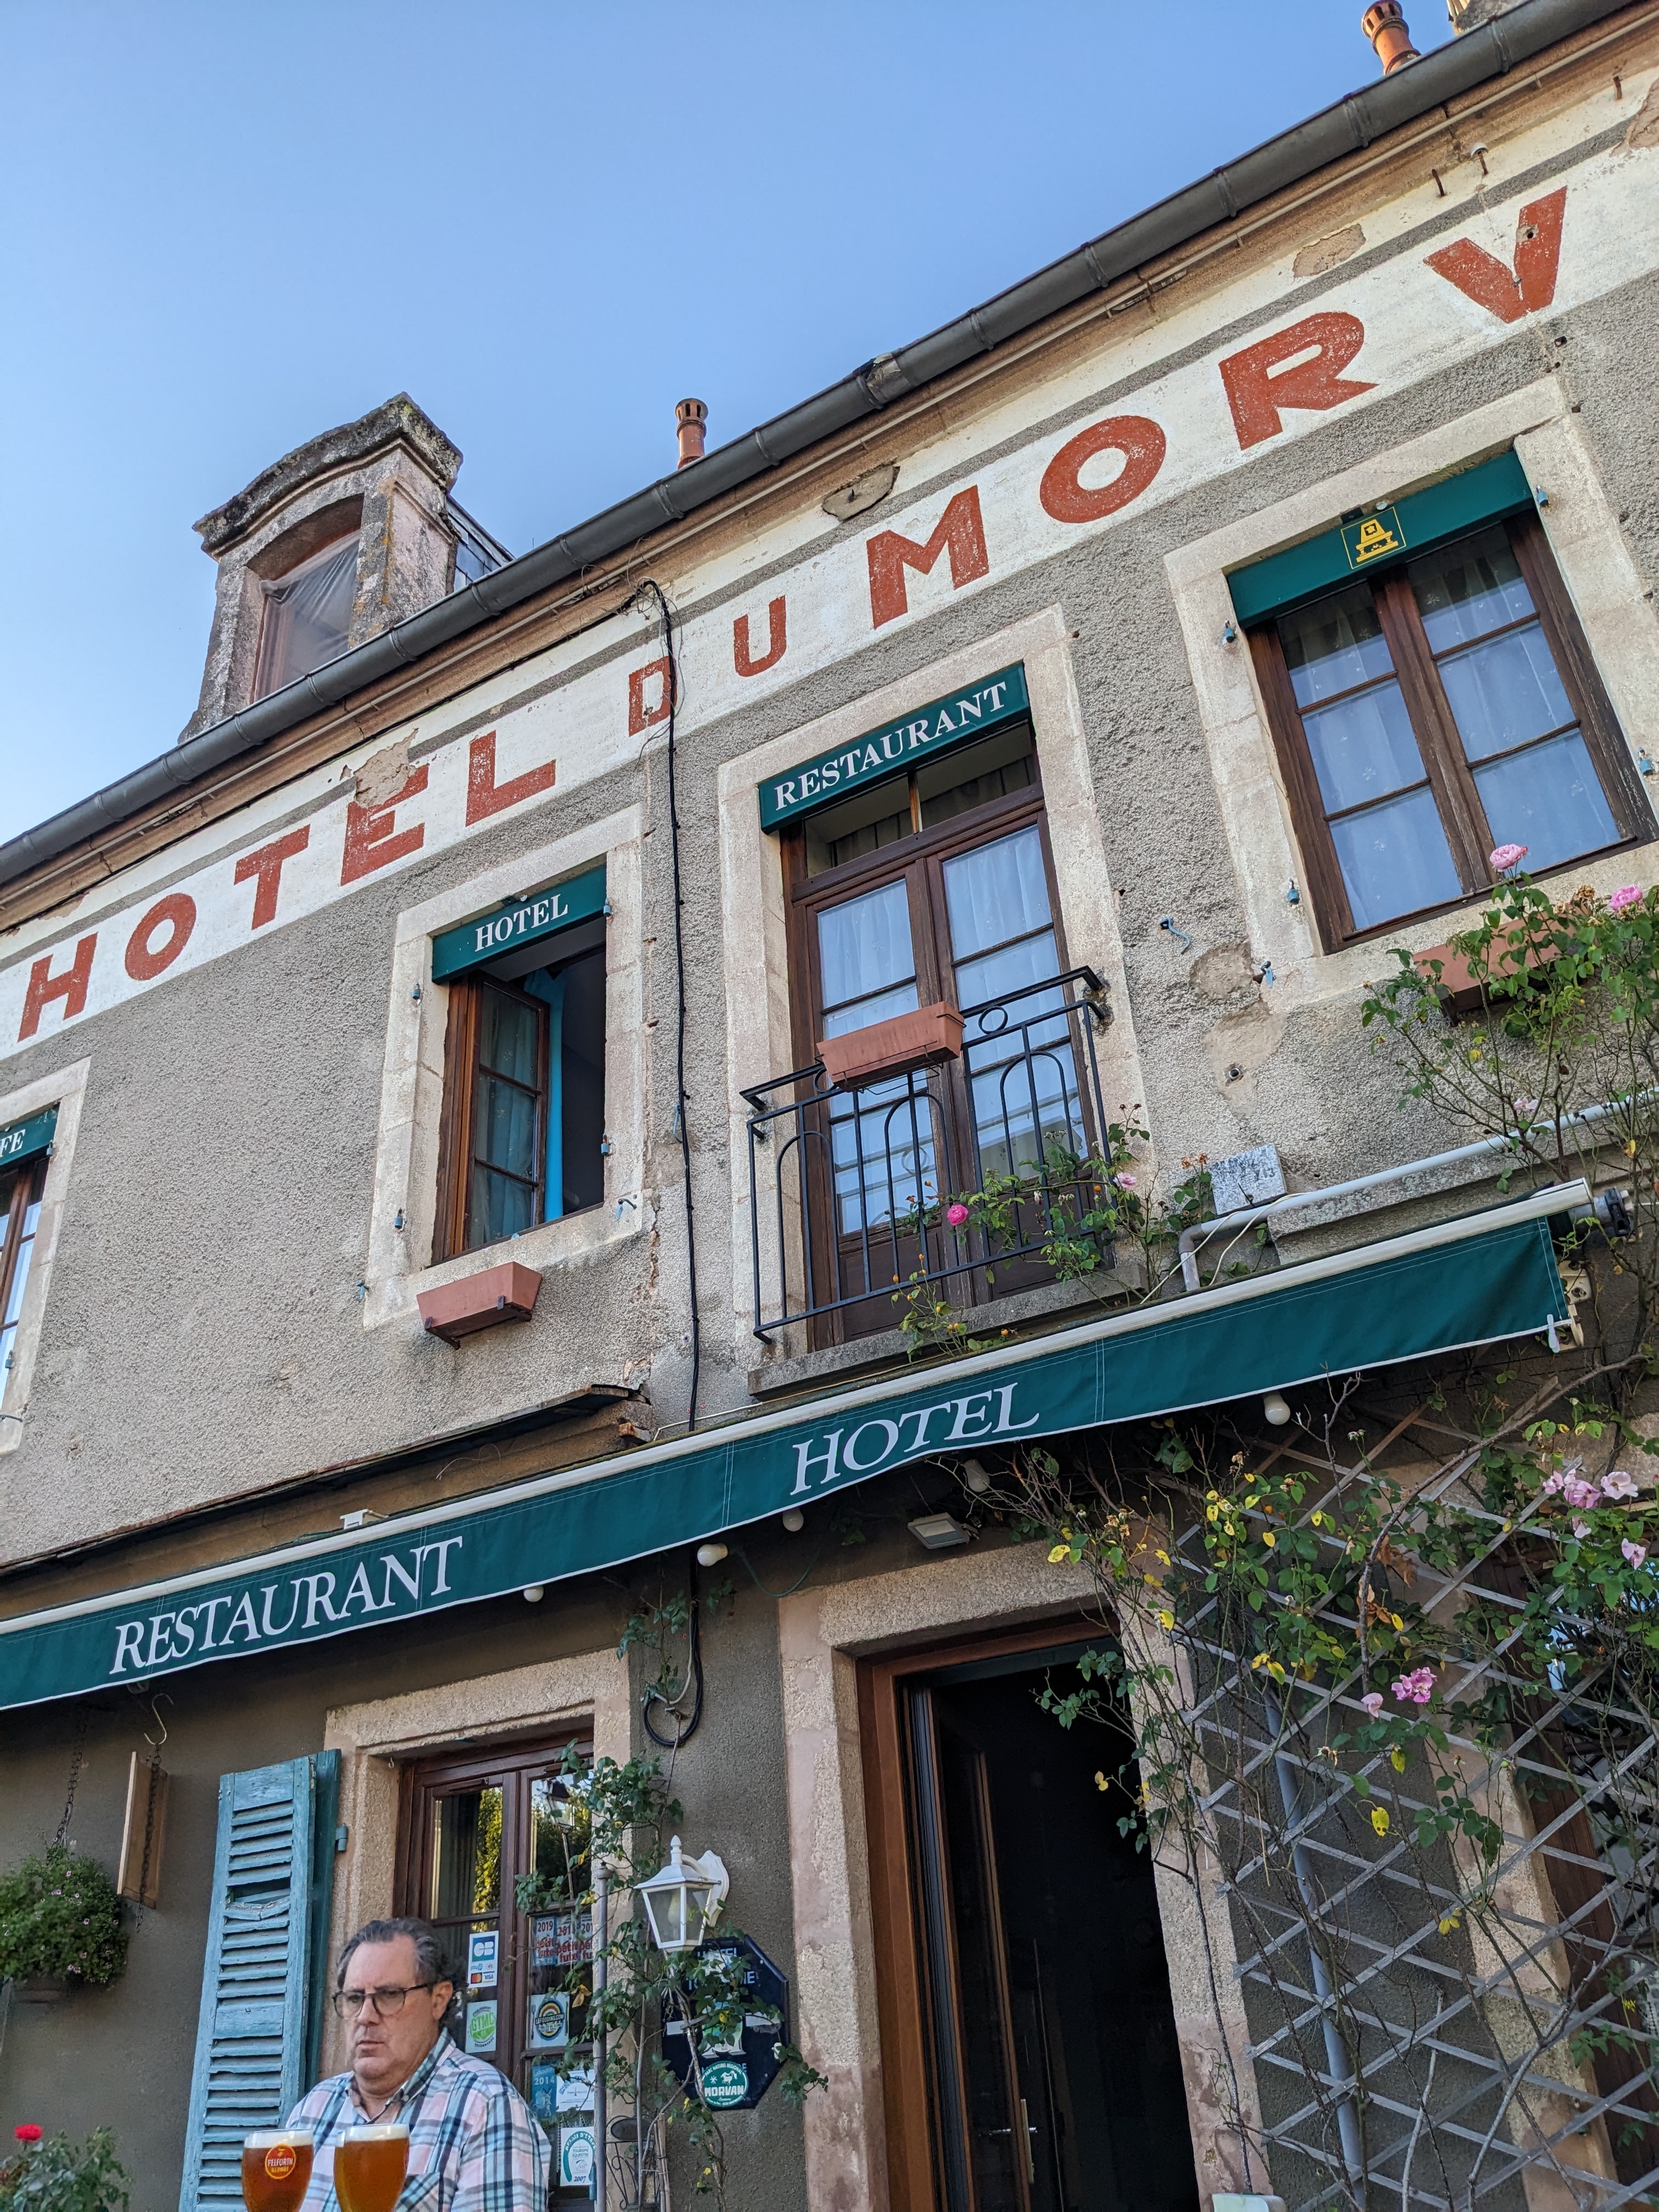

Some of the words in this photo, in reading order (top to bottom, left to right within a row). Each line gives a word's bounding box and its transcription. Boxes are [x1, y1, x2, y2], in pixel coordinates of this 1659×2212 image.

[18, 731, 556, 1042] HOTEL
[628, 595, 786, 736] DU
[866, 186, 1567, 629] MORV
[774, 681, 1008, 810] RESTAURANT
[474, 894, 569, 952] HOTEL
[789, 1382, 1040, 1496] HOTEL
[110, 1537, 463, 1675] RESTAURANT
[538, 1921, 554, 1932] 2019
[474, 1941, 494, 1957] CB
[471, 2012, 494, 2032] GTMC
[705, 2067, 713, 2076] PARC
[534, 2076, 555, 2085] 2014
[704, 2085, 744, 2097] MORVAN
[268, 2157, 294, 2166] PELFORTH
[573, 2175, 586, 2183] 2007
